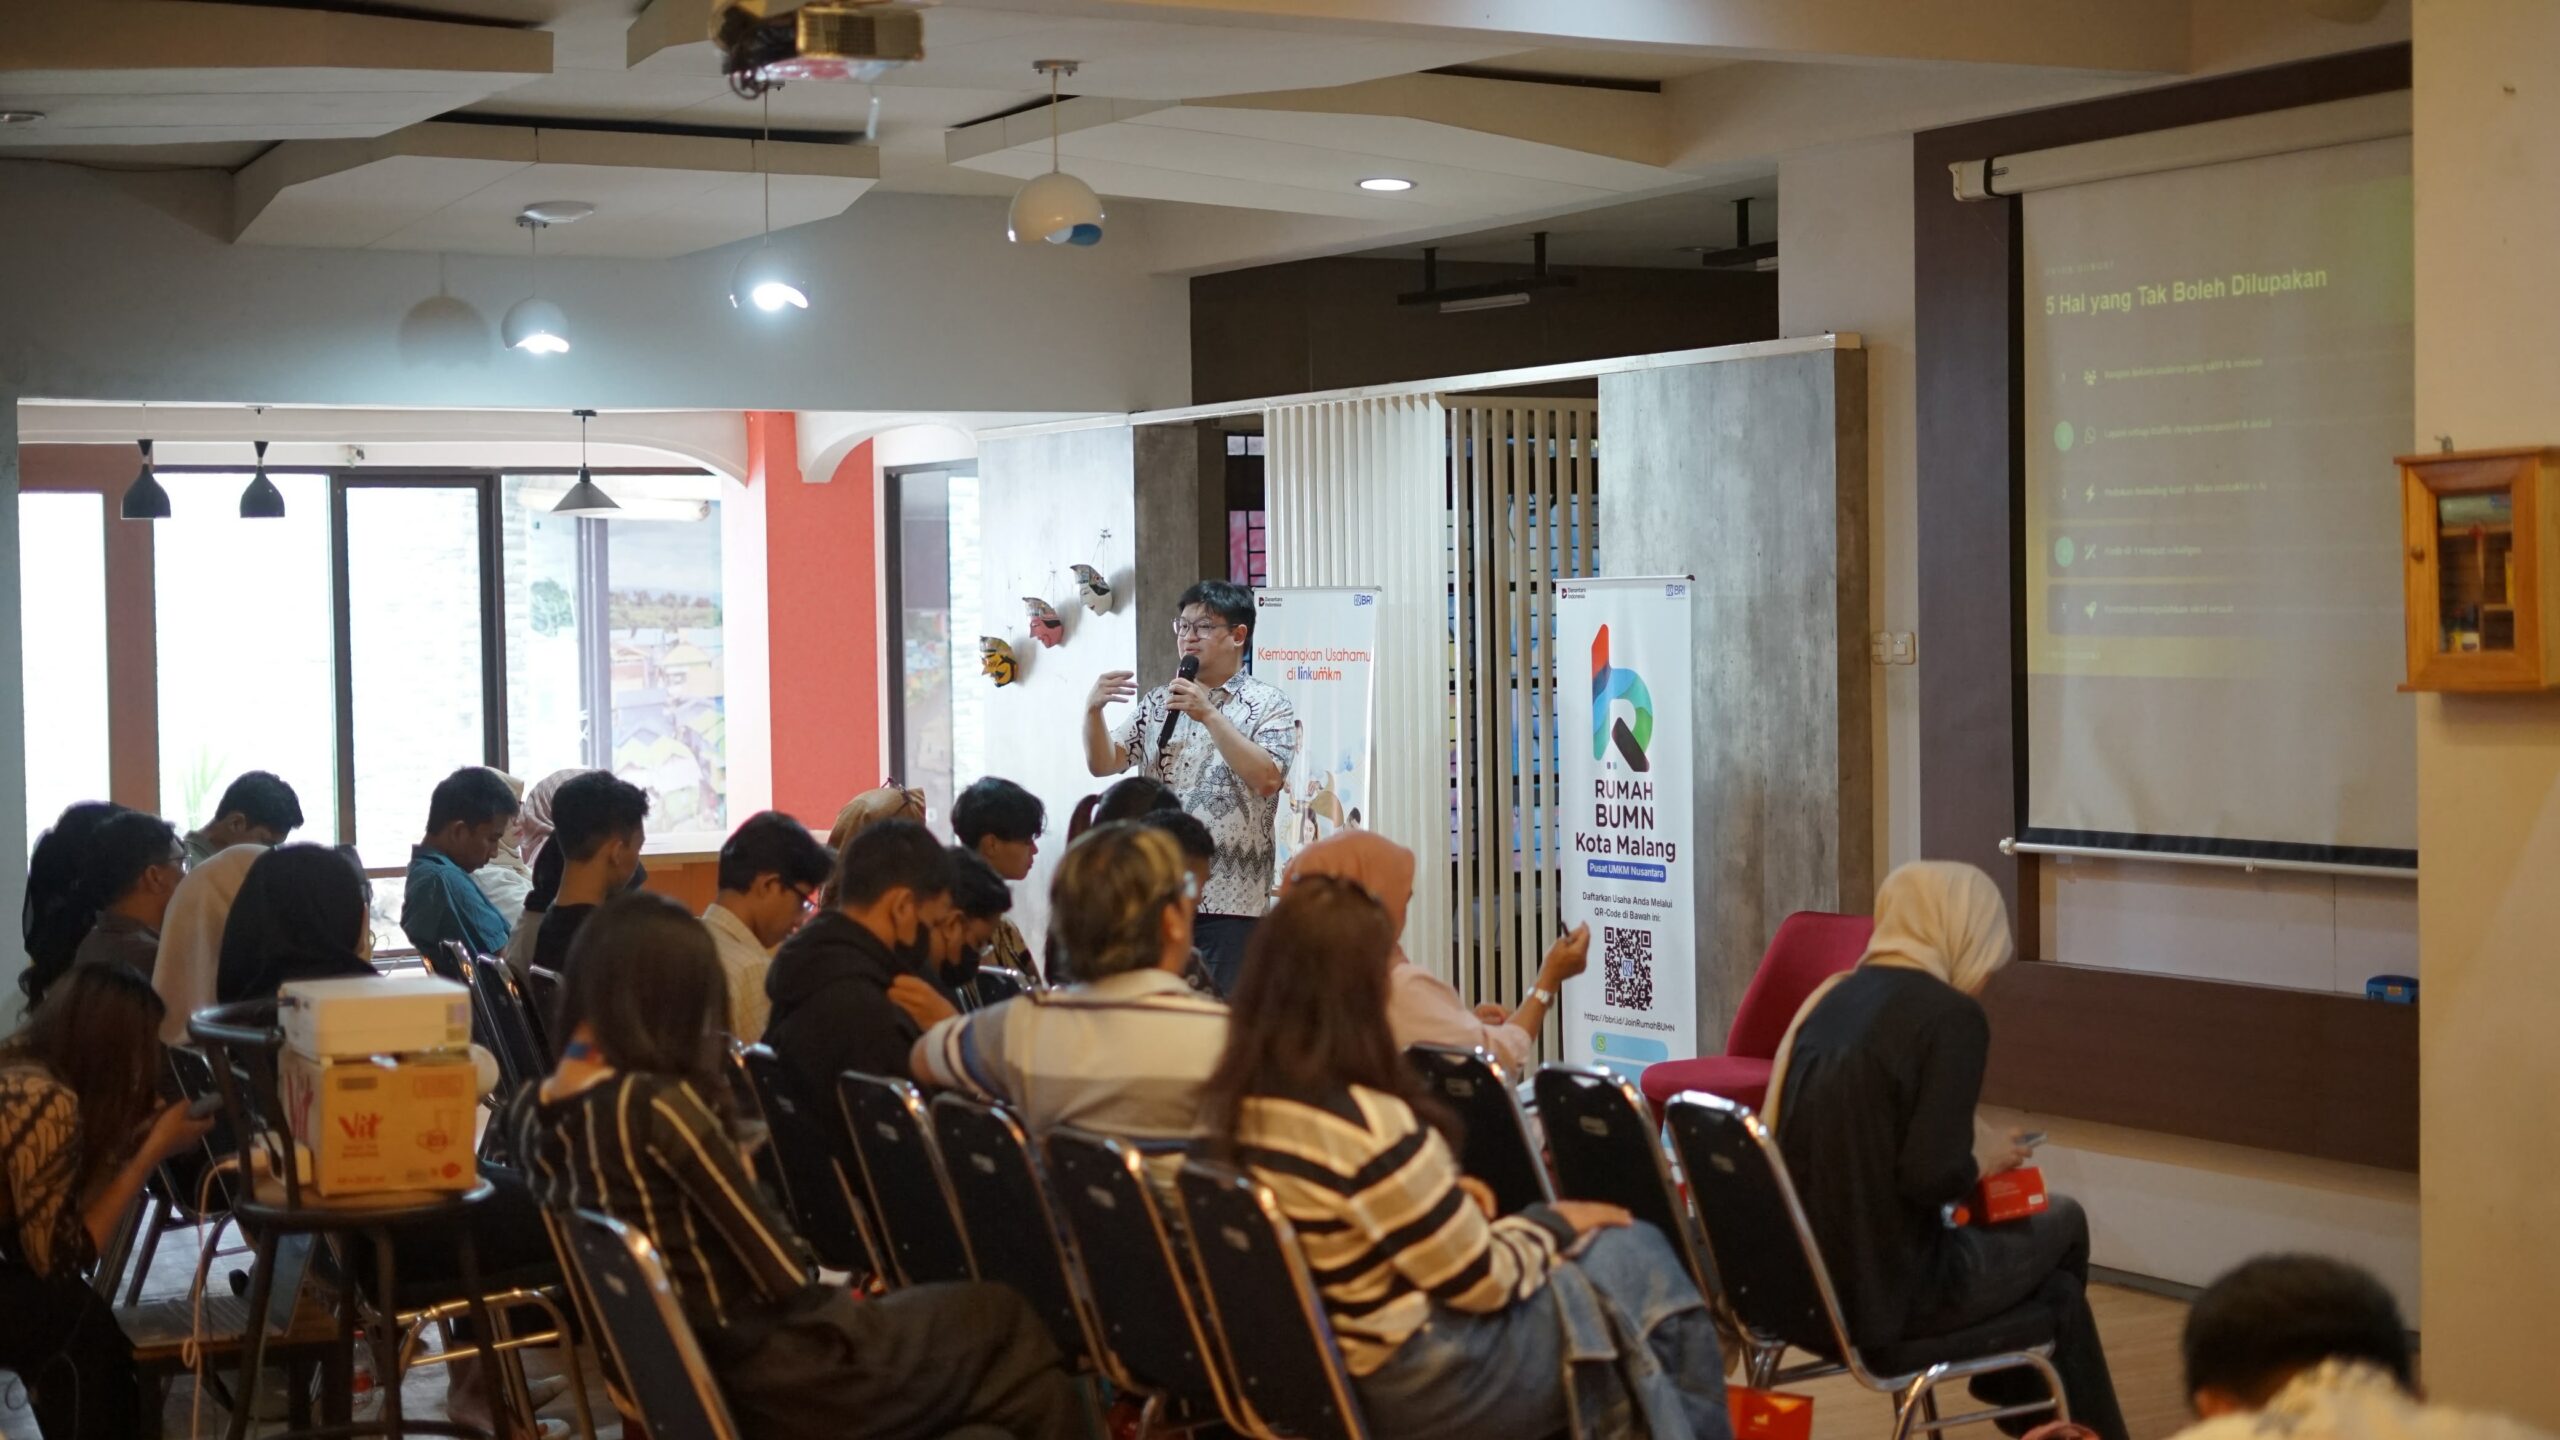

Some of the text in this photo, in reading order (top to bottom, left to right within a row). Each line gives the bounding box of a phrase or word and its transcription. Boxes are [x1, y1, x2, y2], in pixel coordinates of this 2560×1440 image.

[2045, 267, 2328, 316] 5 Hal yang Tak Boleh Dilupakan
[1258, 648, 1371, 665] Kembangkan Usahamu
[1287, 667, 1296, 681] di
[1595, 779, 1653, 801] RUMAH
[1595, 803, 1654, 830] BUMN
[1575, 832, 1676, 862] Kota Malang
[1589, 863, 1664, 878] Pusat UMKM Nusantara
[1582, 891, 1673, 909] Daftarkan Usaha Anda Melalui
[1594, 906, 1621, 919] QR-Code
[1622, 909, 1629, 919] di
[1629, 910, 1651, 921] Bawah
[338, 1112, 383, 1139] Vit
